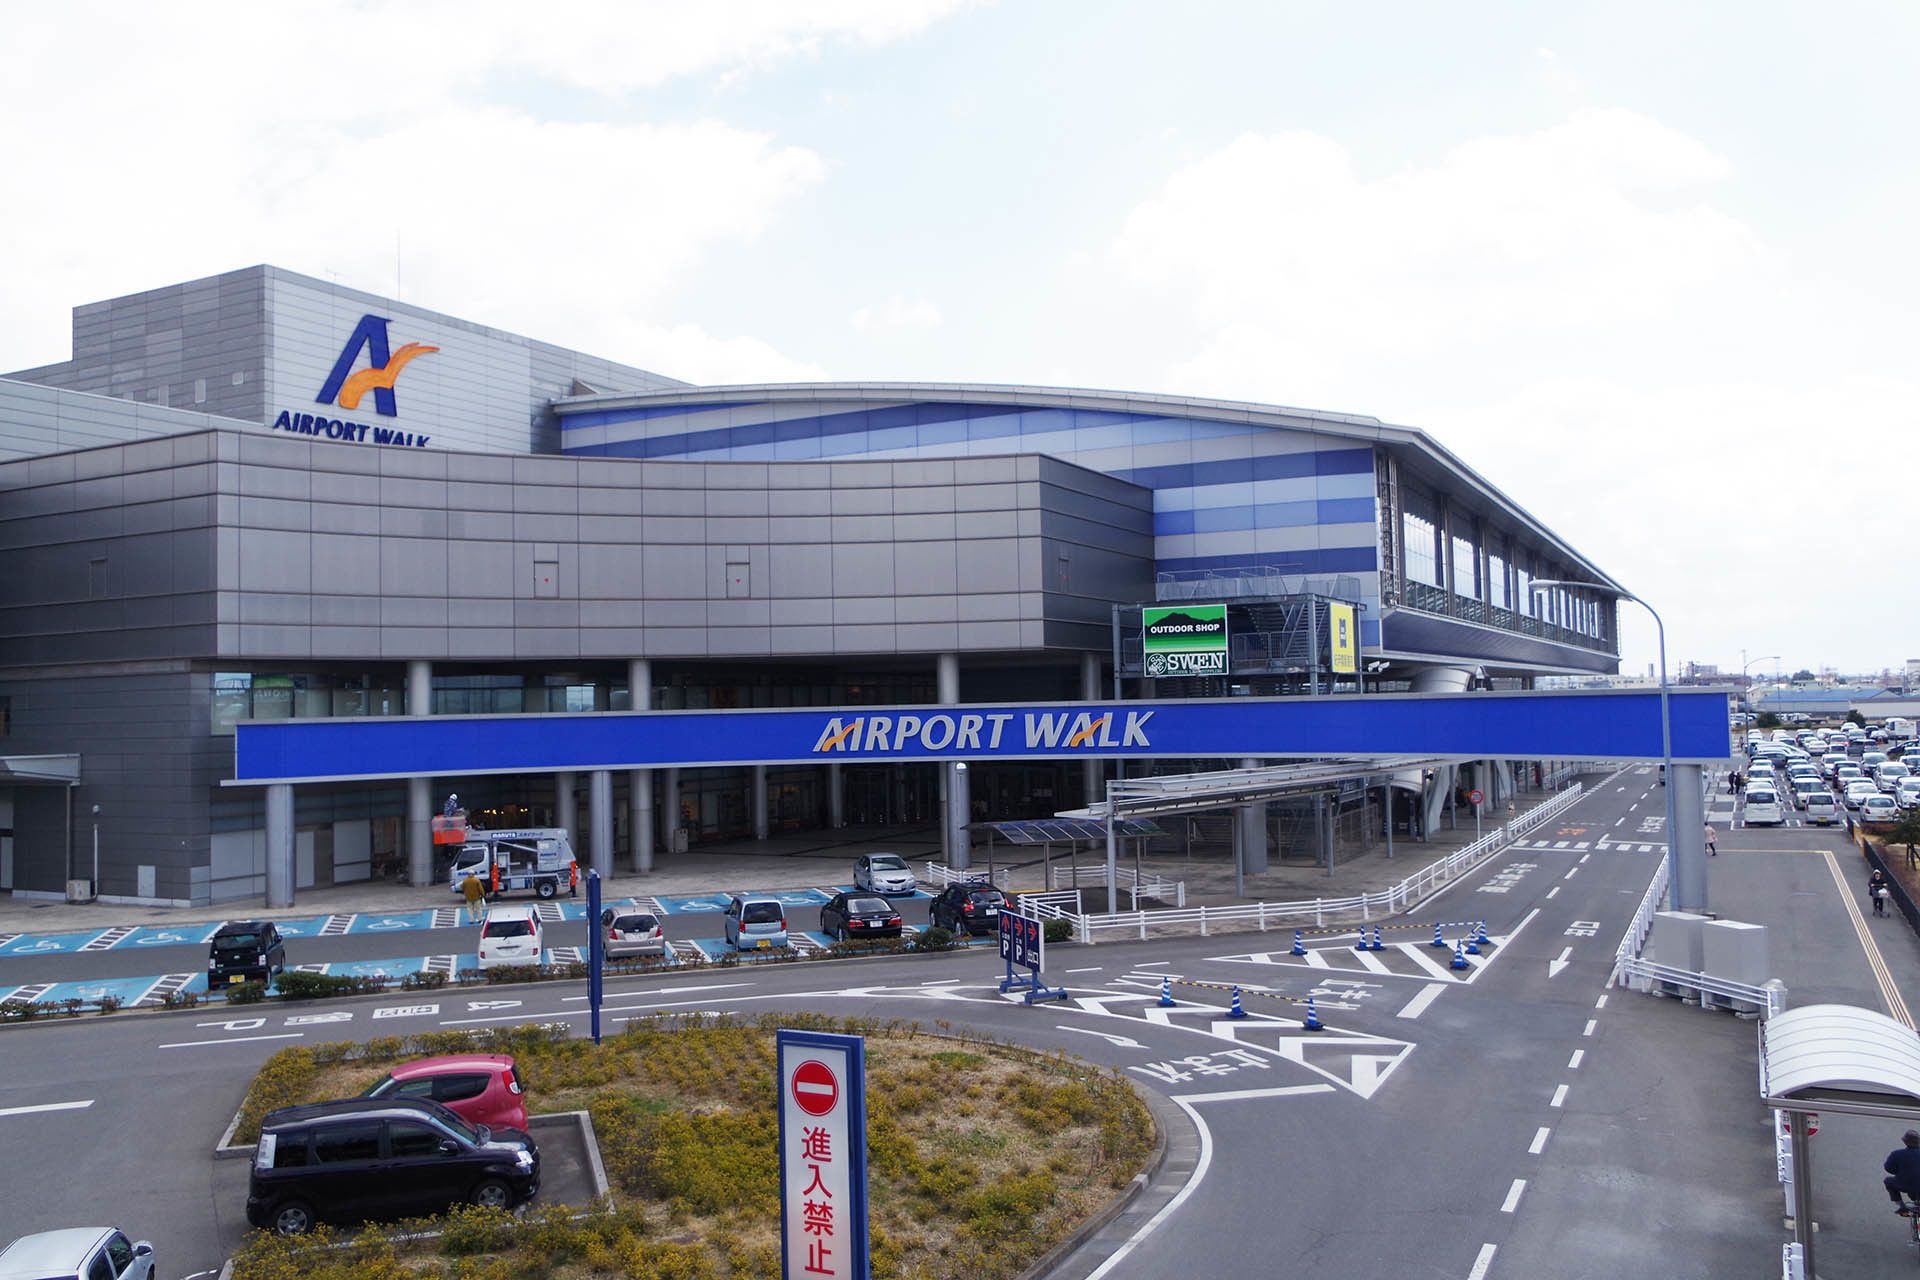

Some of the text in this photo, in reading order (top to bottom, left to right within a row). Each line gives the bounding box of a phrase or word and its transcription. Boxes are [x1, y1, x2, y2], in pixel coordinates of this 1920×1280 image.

[273, 410, 370, 442] AIRPORT
[1150, 624, 1220, 634] OUTDOOR SHOP
[1167, 652, 1225, 670] SWEN
[812, 711, 1154, 752] AIRPORT WALK
[1003, 940, 1009, 956] P
[1016, 944, 1022, 960] P
[1128, 1049, 1271, 1084] 止まれ
[801, 1126, 835, 1276] 進入禁止
